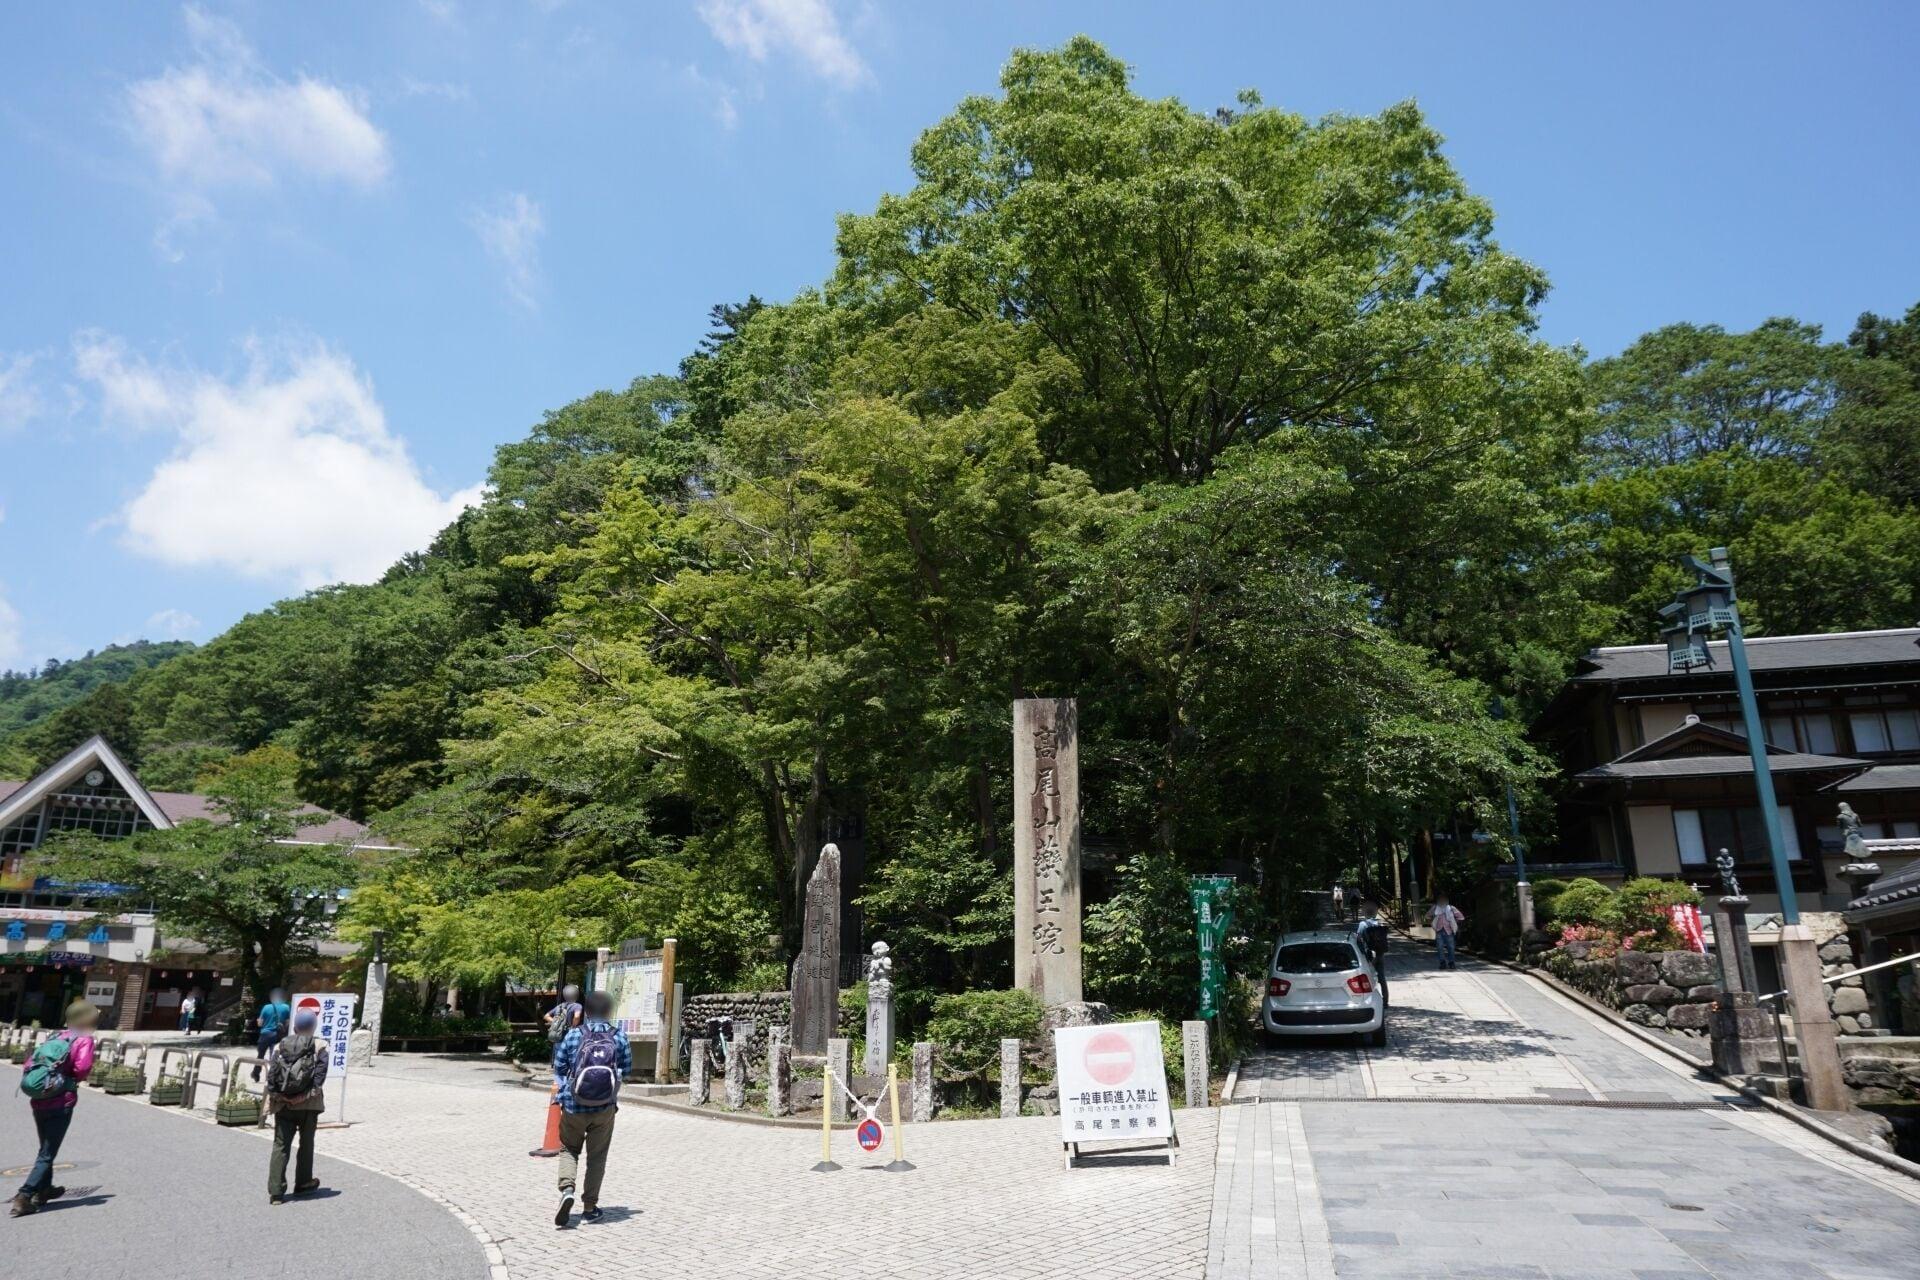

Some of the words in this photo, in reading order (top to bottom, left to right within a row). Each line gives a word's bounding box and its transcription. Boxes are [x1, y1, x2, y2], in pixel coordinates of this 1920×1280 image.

[1200, 901, 1214, 1011] 登山安全
[321, 999, 336, 1046] 歩行者
[333, 1005, 350, 1071] この広場は、
[1074, 1116, 1157, 1131] 高尾警察署
